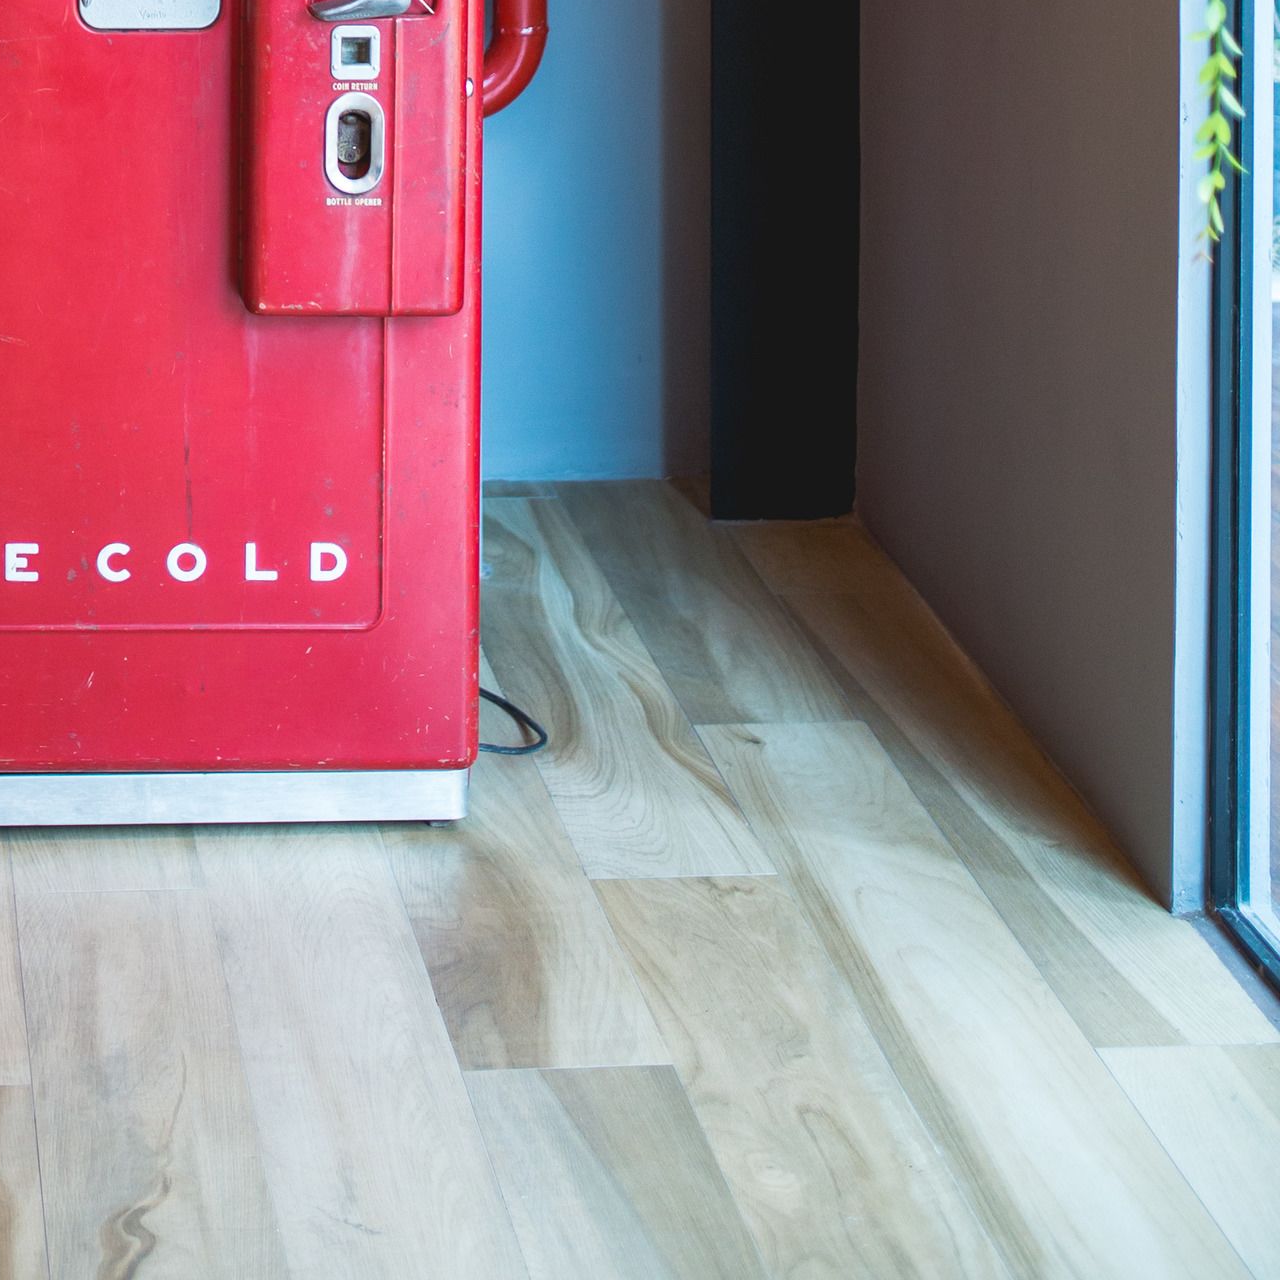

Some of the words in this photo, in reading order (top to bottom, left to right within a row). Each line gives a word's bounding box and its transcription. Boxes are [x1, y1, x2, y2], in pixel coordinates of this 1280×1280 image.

[332, 82, 350, 90] COIN
[351, 82, 378, 90] RETURN
[326, 197, 352, 206] BOTTLE
[354, 197, 382, 206] OPENER
[96, 542, 348, 582] COLD
